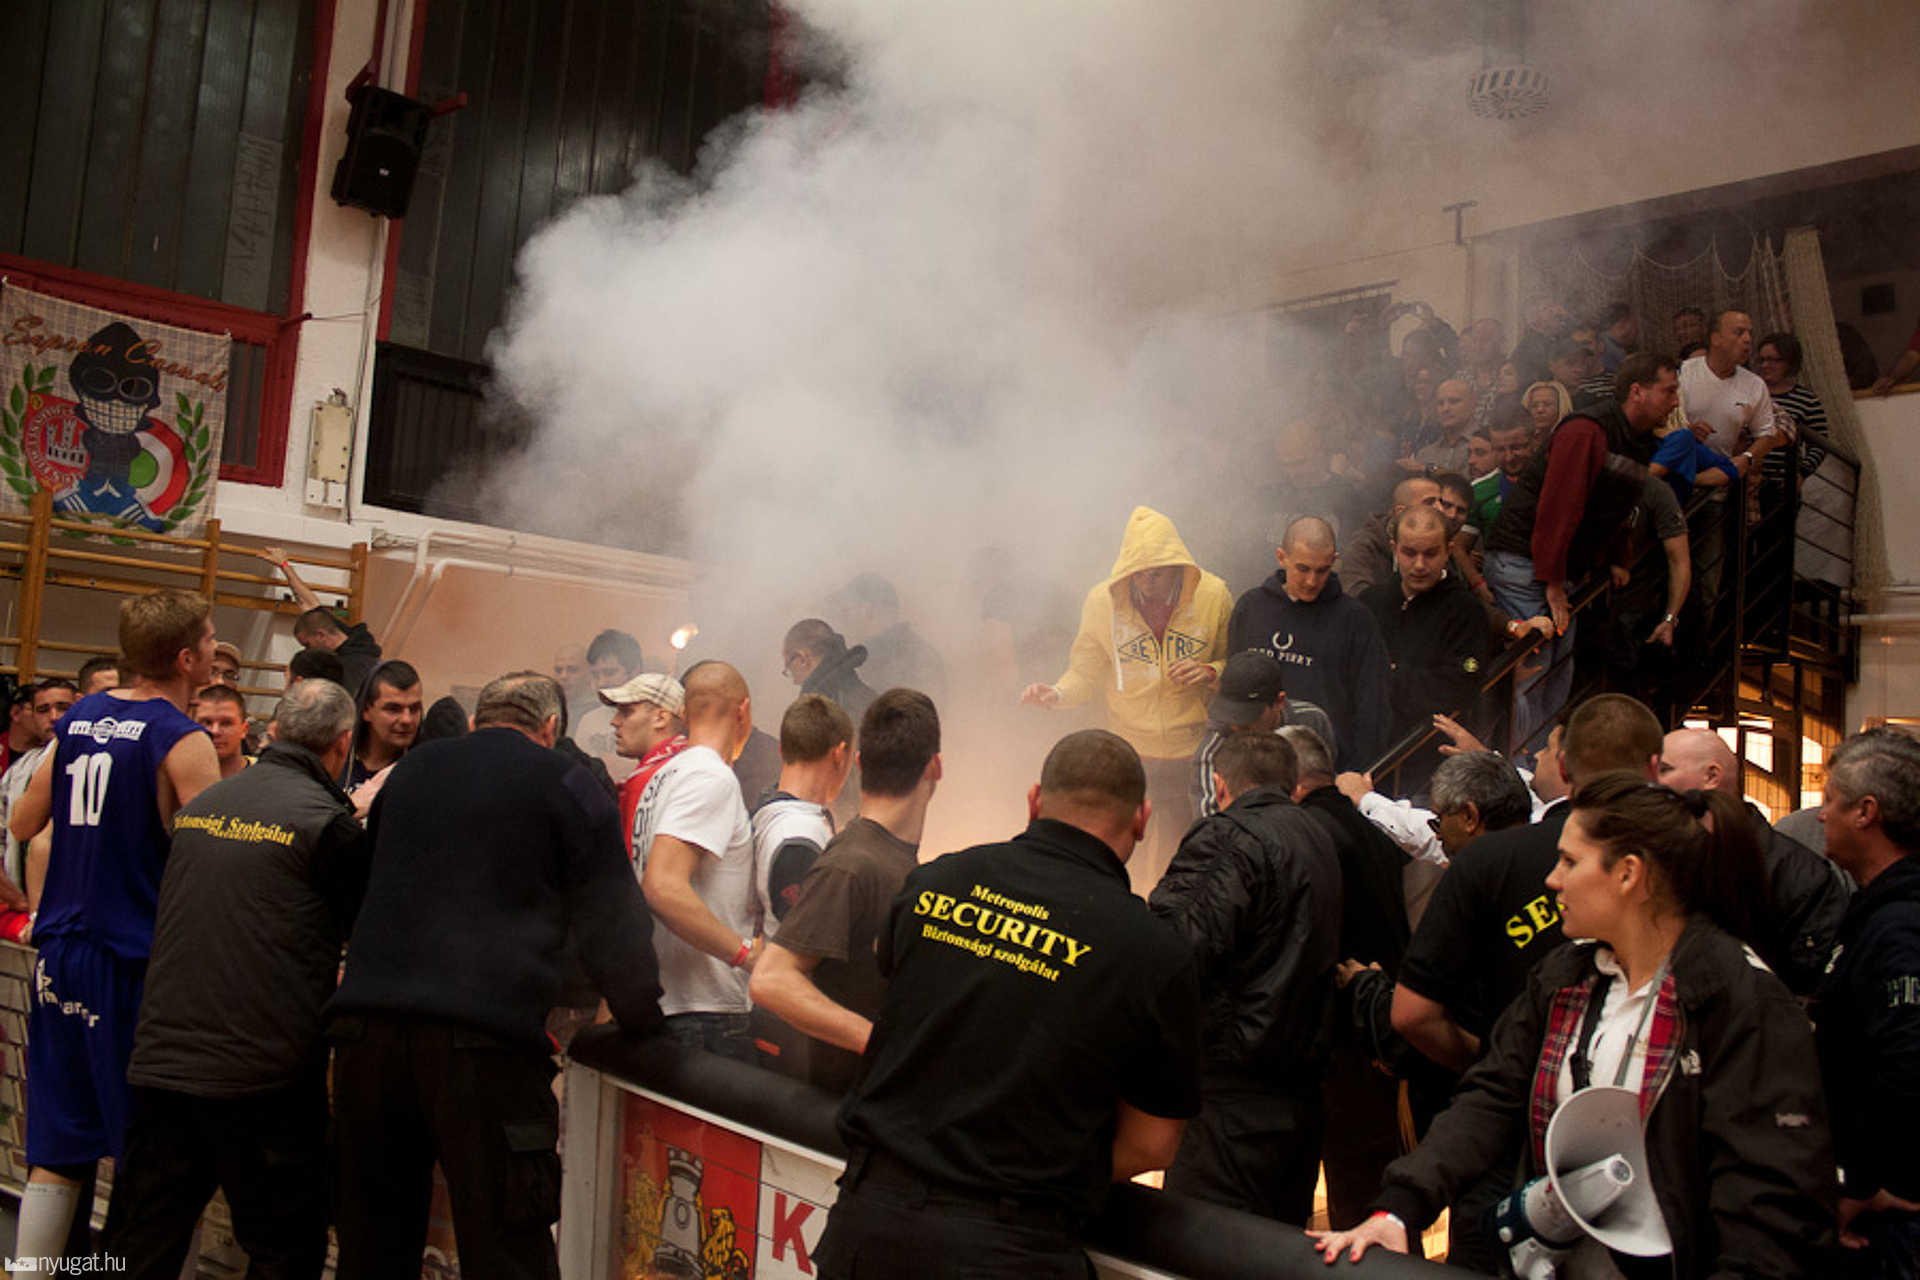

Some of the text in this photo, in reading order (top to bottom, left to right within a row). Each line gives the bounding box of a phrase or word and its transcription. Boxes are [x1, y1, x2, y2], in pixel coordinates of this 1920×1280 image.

[66, 752, 113, 827] 10
[913, 889, 1092, 967] SECURITY
[969, 883, 1051, 921] Metropolis
[1505, 894, 1566, 950] SE
[921, 923, 1061, 983] Biztonsági szolgálat
